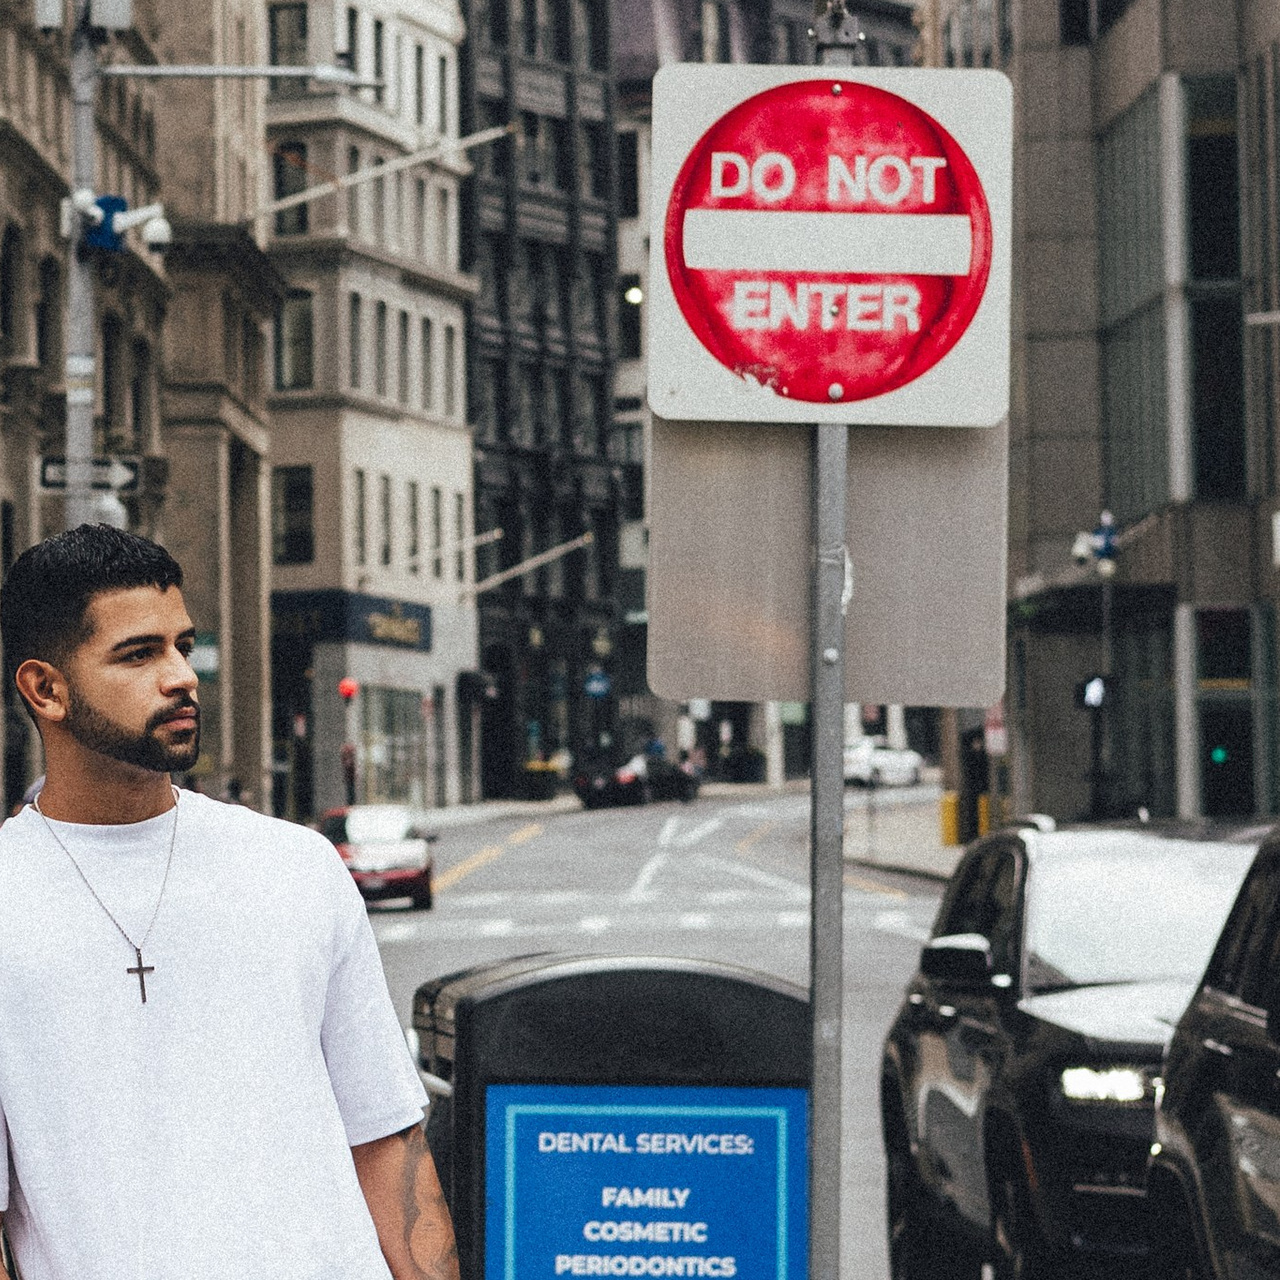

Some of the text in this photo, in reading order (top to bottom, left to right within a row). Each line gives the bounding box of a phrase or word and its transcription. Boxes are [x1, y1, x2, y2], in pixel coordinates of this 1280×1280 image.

[710, 150, 948, 207] DO NOT
[732, 279, 922, 334] ENTER
[538, 1131, 755, 1155] DENTAL SERVICES:
[601, 1186, 691, 1209] FAMILY
[582, 1220, 708, 1243] COSMETIC
[554, 1254, 737, 1278] PERIODONTICS
